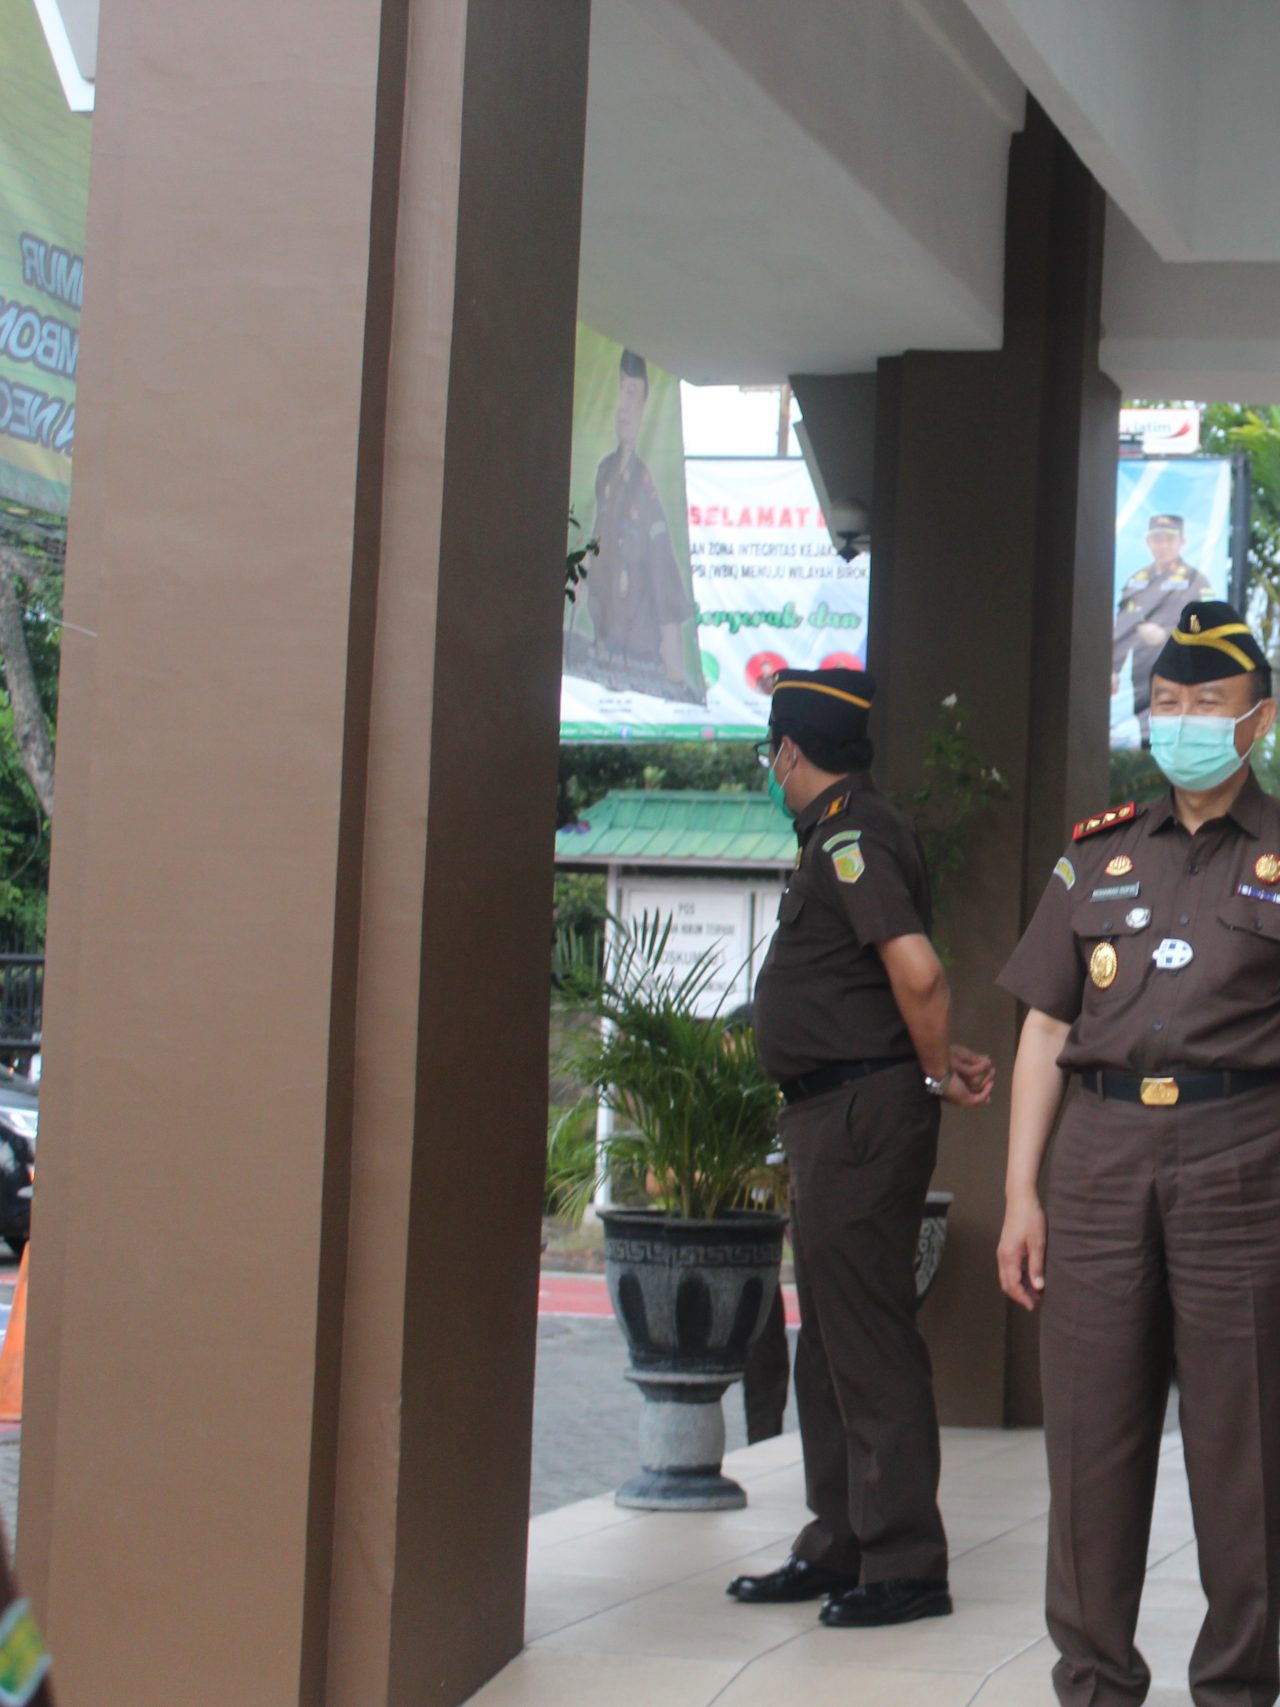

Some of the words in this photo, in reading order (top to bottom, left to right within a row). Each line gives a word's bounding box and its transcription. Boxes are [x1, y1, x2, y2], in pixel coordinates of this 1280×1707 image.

[688, 505, 811, 529] SELAMAT
[738, 542, 797, 558] INTEGRITAS
[788, 564, 834, 579] WILAYAH
[808, 600, 862, 630] dan
